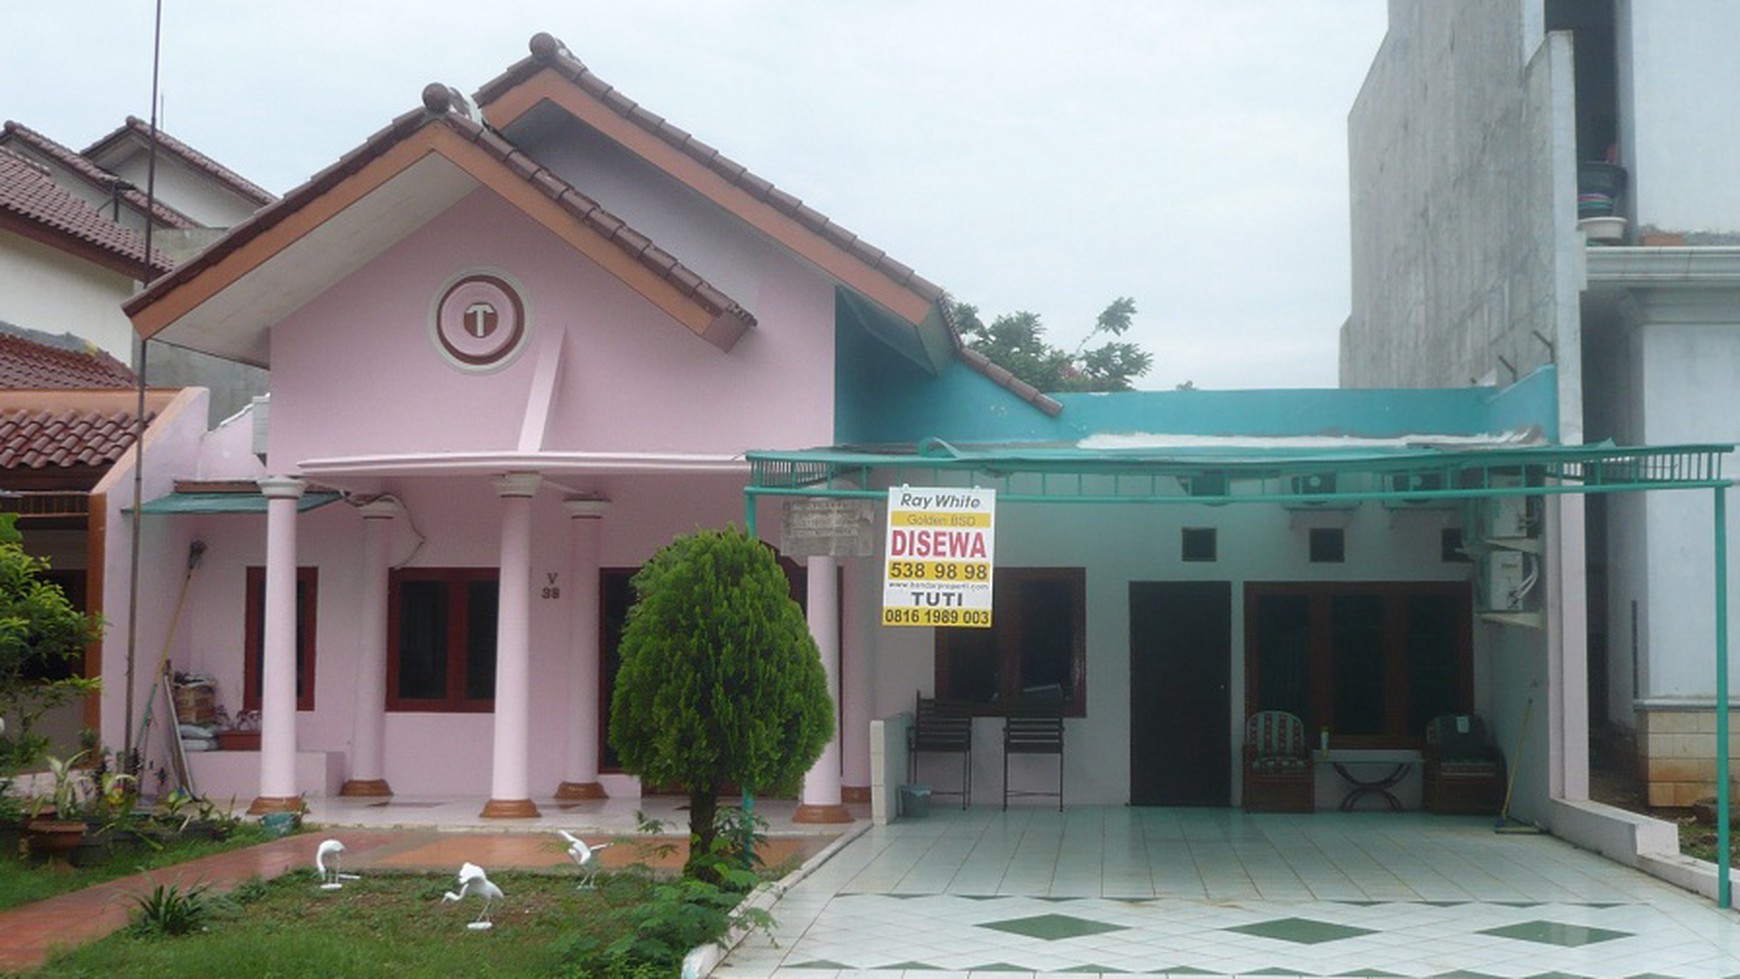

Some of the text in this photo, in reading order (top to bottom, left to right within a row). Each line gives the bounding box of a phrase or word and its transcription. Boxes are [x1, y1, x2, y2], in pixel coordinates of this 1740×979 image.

[466, 304, 495, 337] T
[900, 493, 981, 509] Ray White
[907, 514, 947, 525] Golden
[891, 530, 986, 557] DISEWA
[547, 572, 558, 585] V
[890, 562, 987, 580] 538 98 98
[911, 592, 963, 606] TUTI
[885, 608, 989, 624] 0816 1989 003
